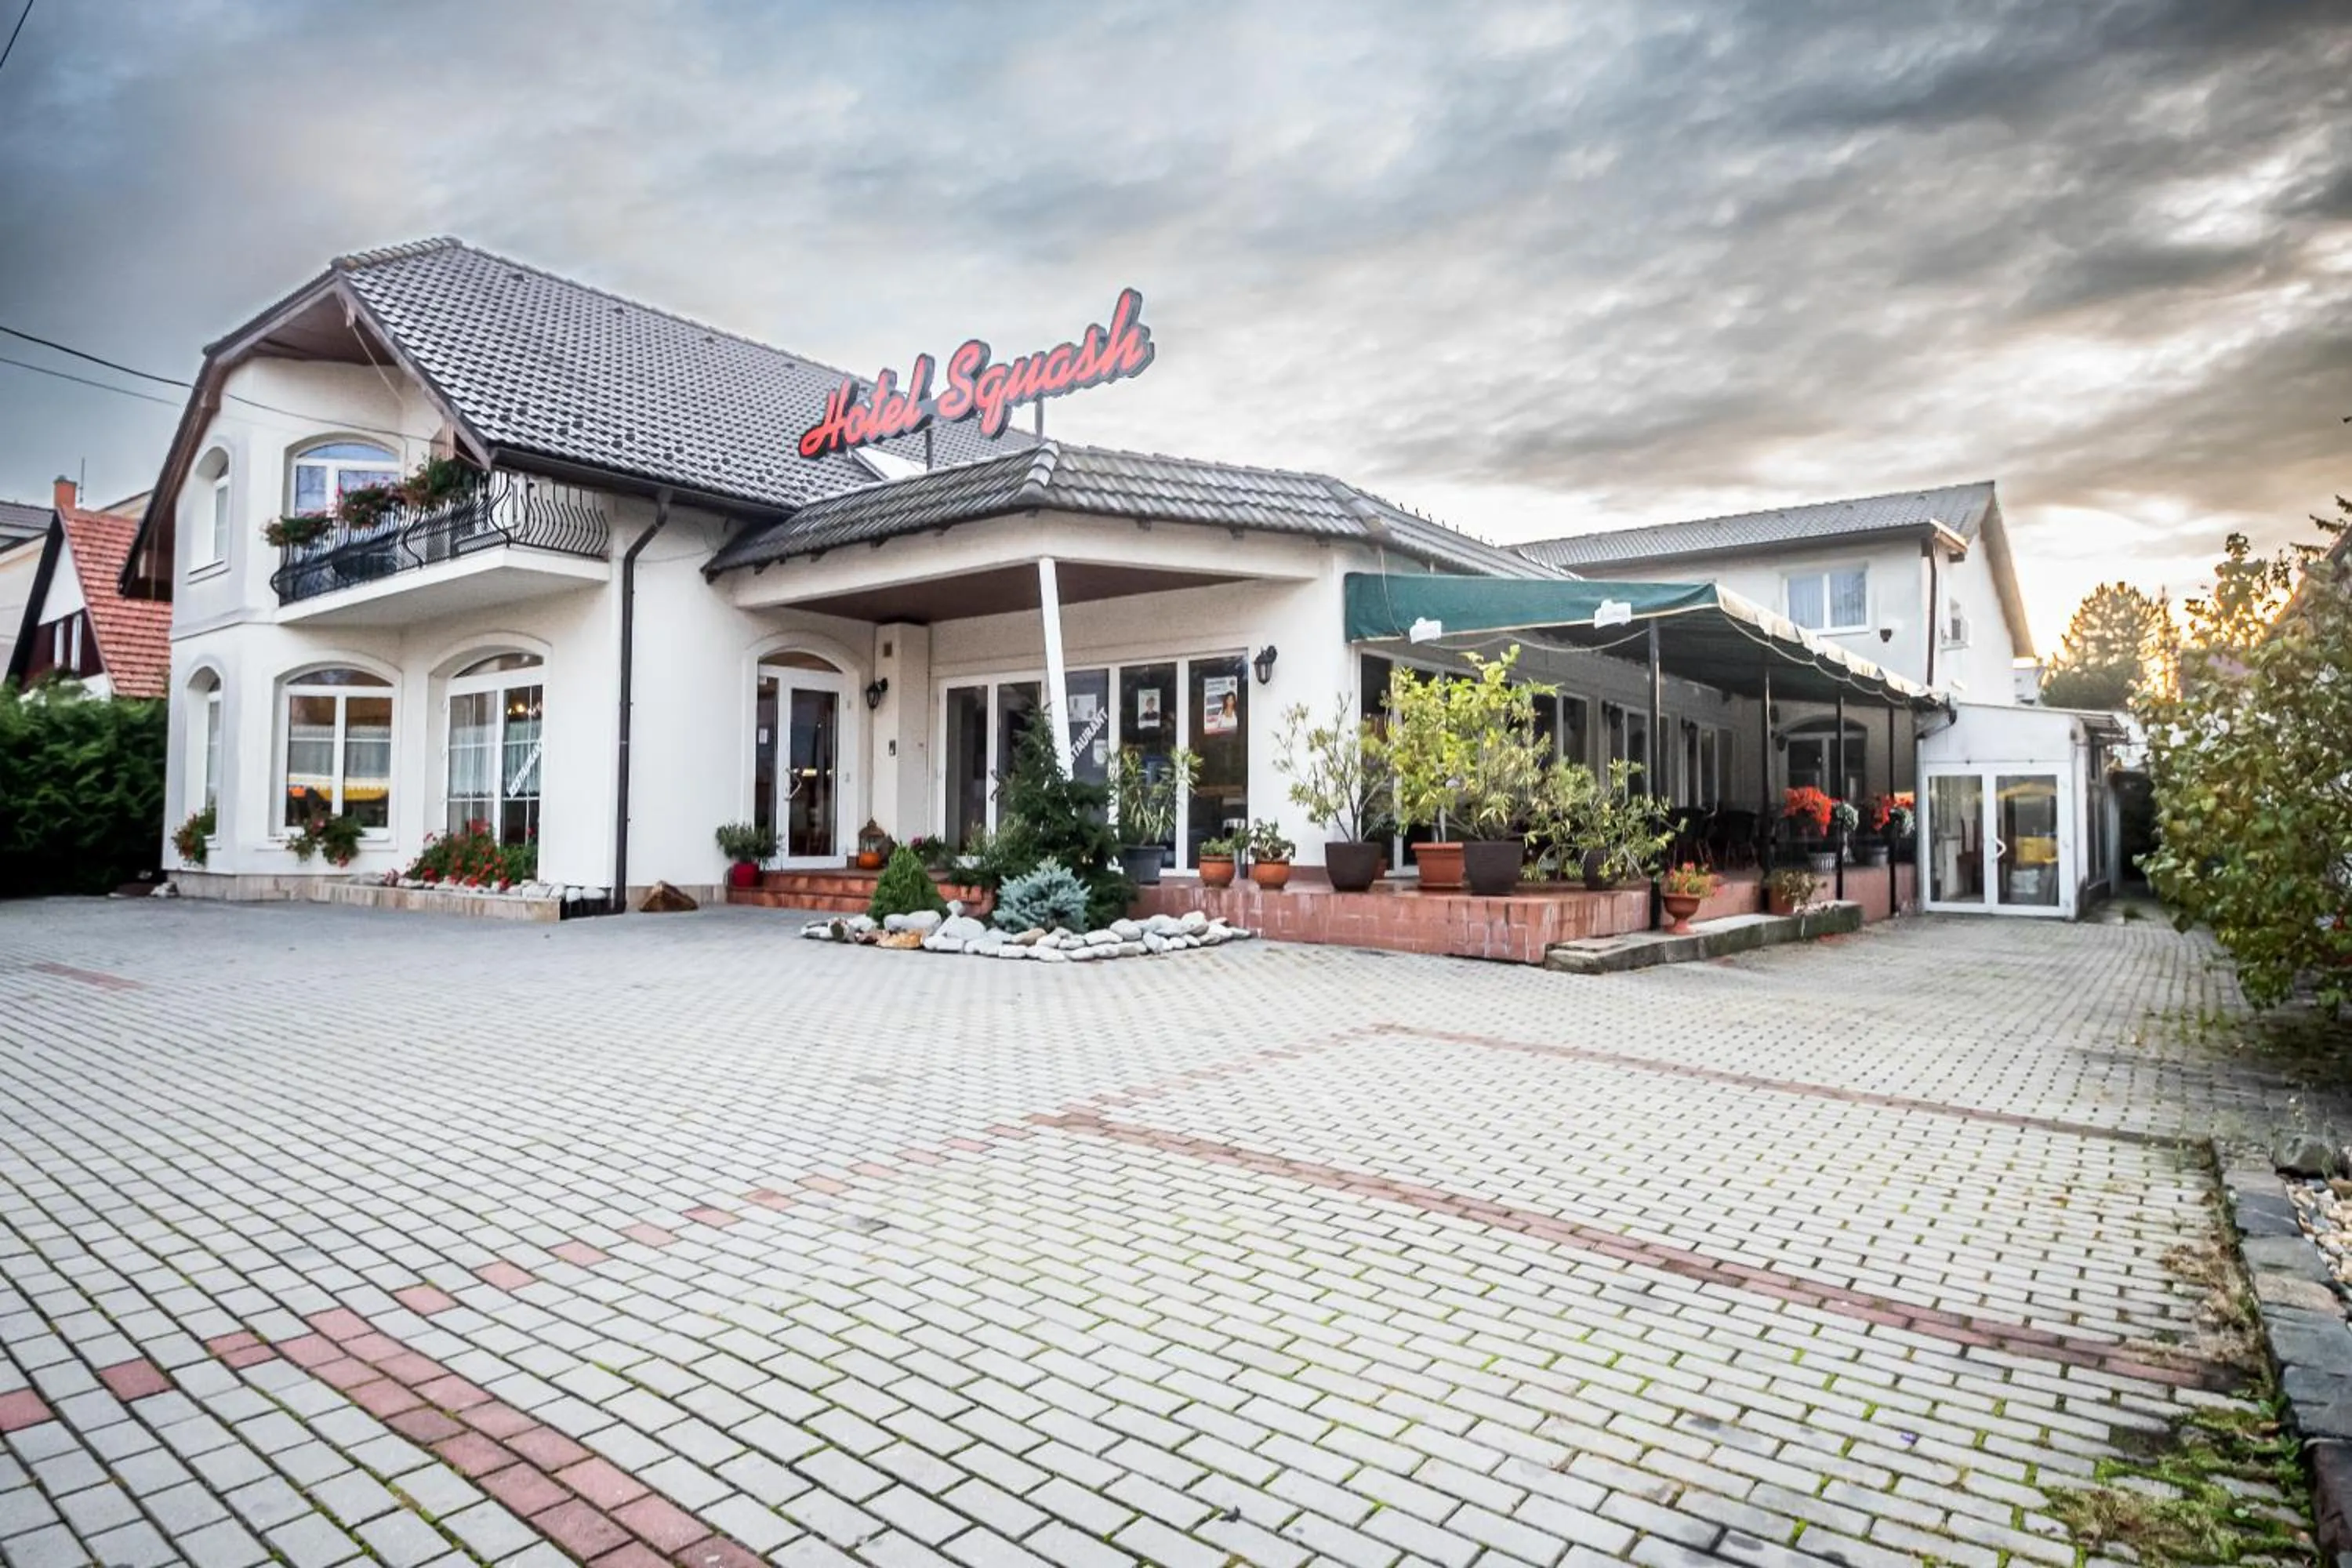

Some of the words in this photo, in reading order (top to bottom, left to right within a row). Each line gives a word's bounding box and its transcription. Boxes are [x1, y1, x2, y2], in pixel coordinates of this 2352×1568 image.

[799, 353, 931, 457] Hotel
[938, 286, 1153, 440] Squash
[1070, 706, 1108, 764] STAURANT
